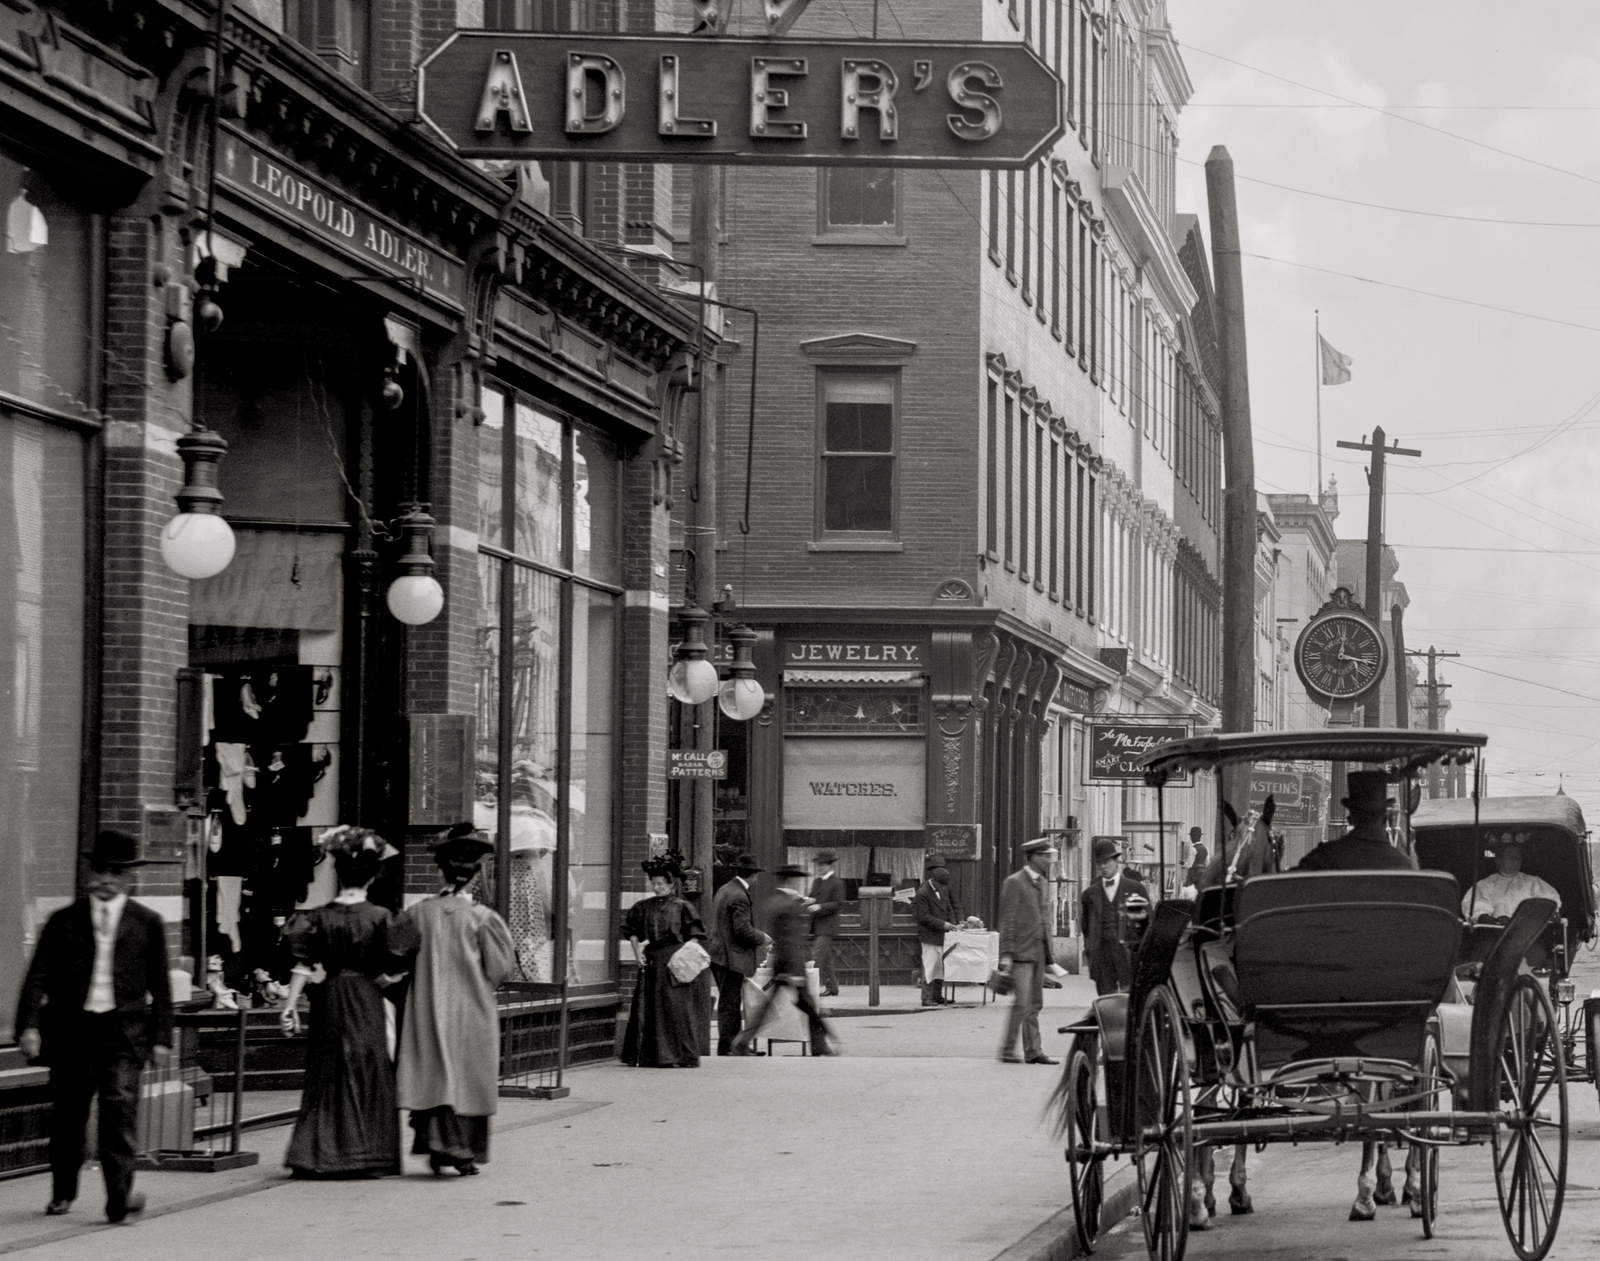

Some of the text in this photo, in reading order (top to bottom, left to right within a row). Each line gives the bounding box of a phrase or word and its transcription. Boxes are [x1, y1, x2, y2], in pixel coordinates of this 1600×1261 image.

[474, 49, 1003, 142] ADLER'S
[251, 155, 433, 281] LEOPOLD ADLER.
[791, 644, 919, 661] JEWELRY.
[1095, 755, 1121, 769] SMART
[671, 766, 725, 778] PATTERNS
[809, 781, 898, 797] WATCHES.
